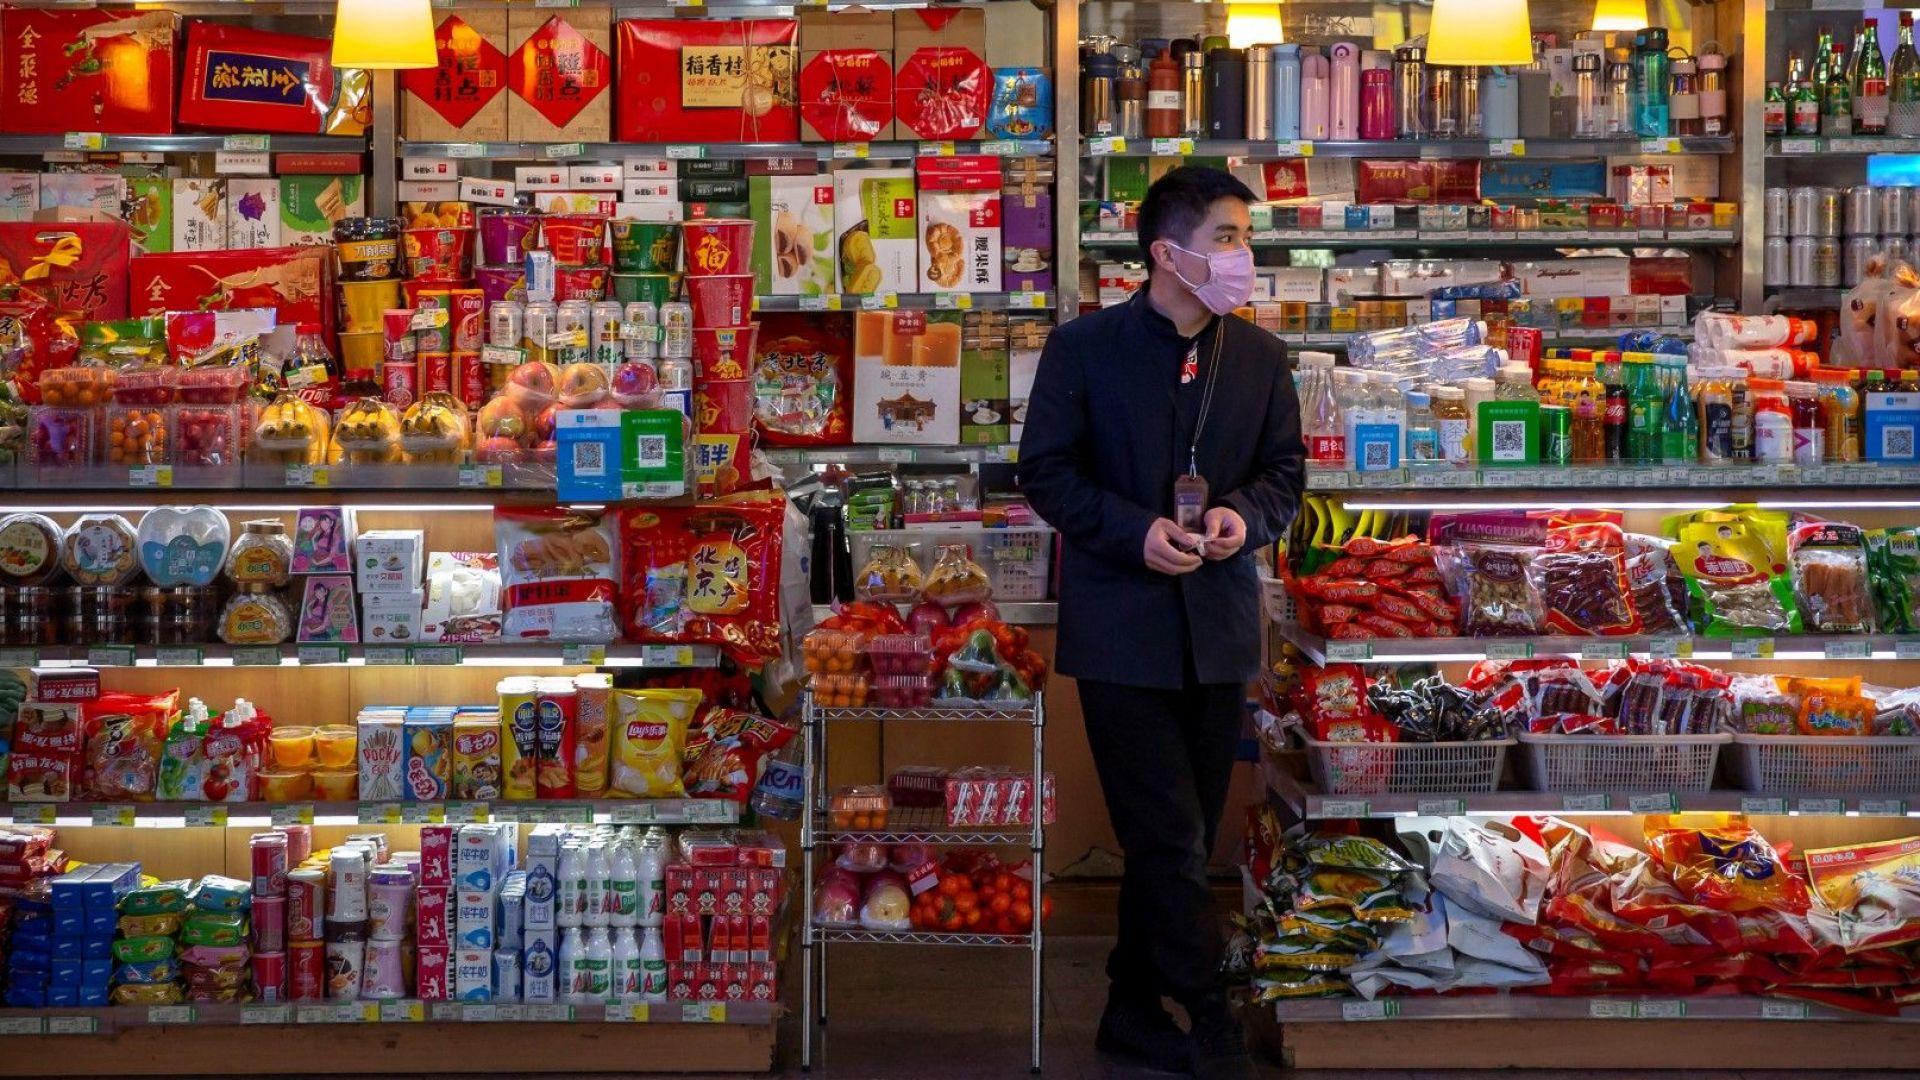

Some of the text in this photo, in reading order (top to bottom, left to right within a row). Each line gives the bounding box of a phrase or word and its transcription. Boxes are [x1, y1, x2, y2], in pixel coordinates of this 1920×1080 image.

[686, 54, 745, 77] 稻香村
[692, 235, 731, 272] 福
[975, 237, 989, 284] 腰果酥
[693, 546, 721, 598] 北京
[362, 744, 401, 764] POCKY
[461, 848, 490, 864] 纯牛奶
[459, 906, 489, 921] 纯牛奶
[458, 964, 488, 980] 纯牛奶
